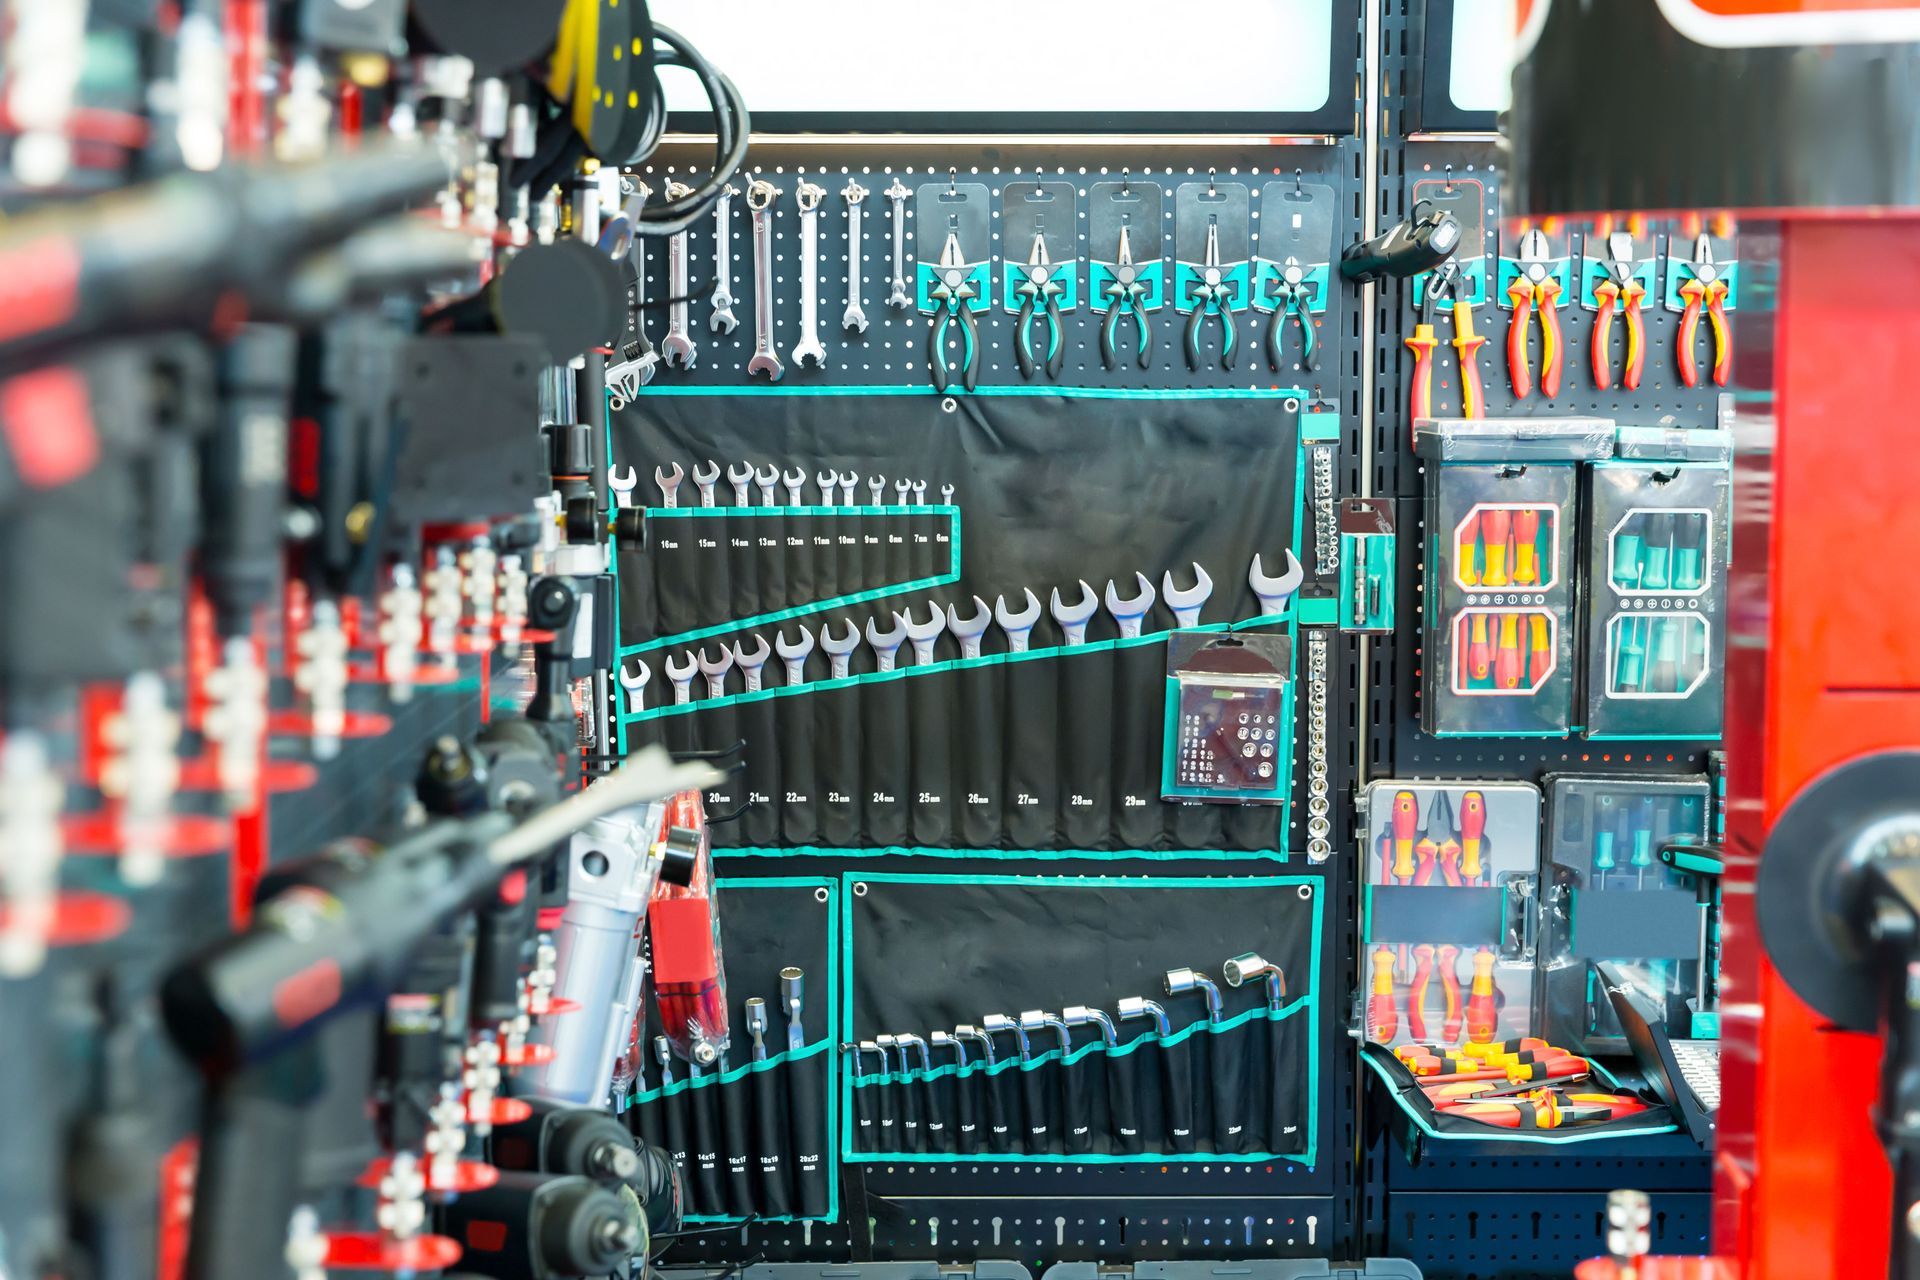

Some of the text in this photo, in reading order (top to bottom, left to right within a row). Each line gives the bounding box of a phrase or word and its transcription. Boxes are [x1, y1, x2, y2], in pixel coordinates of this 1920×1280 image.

[698, 538, 717, 548] 15mm
[731, 538, 749, 547] 14mm
[758, 537, 777, 547] 13mm
[786, 536, 804, 546] 12mm
[813, 536, 831, 545] 11mm
[838, 535, 856, 545] 10mm
[864, 534, 879, 544] 9mm
[888, 534, 903, 544] 8mm
[913, 533, 928, 543] 7mm
[936, 533, 949, 543] 6mm
[660, 539, 679, 549] 16mm
[709, 792, 731, 803] 20mm
[748, 791, 770, 803] 21mm
[786, 791, 807, 803] 22mm
[828, 791, 850, 803] 23mm
[873, 792, 895, 803] 24mm
[918, 792, 941, 803] 25mm
[968, 793, 989, 804] 26mm
[1017, 793, 1039, 805] 27mm
[1071, 794, 1093, 806] 28mm
[1124, 795, 1146, 807] 29mm
[697, 1152, 716, 1161] 14x15
[728, 1155, 747, 1165] 16x17
[760, 1155, 779, 1164] 18x19
[799, 1154, 819, 1163] 20x22
